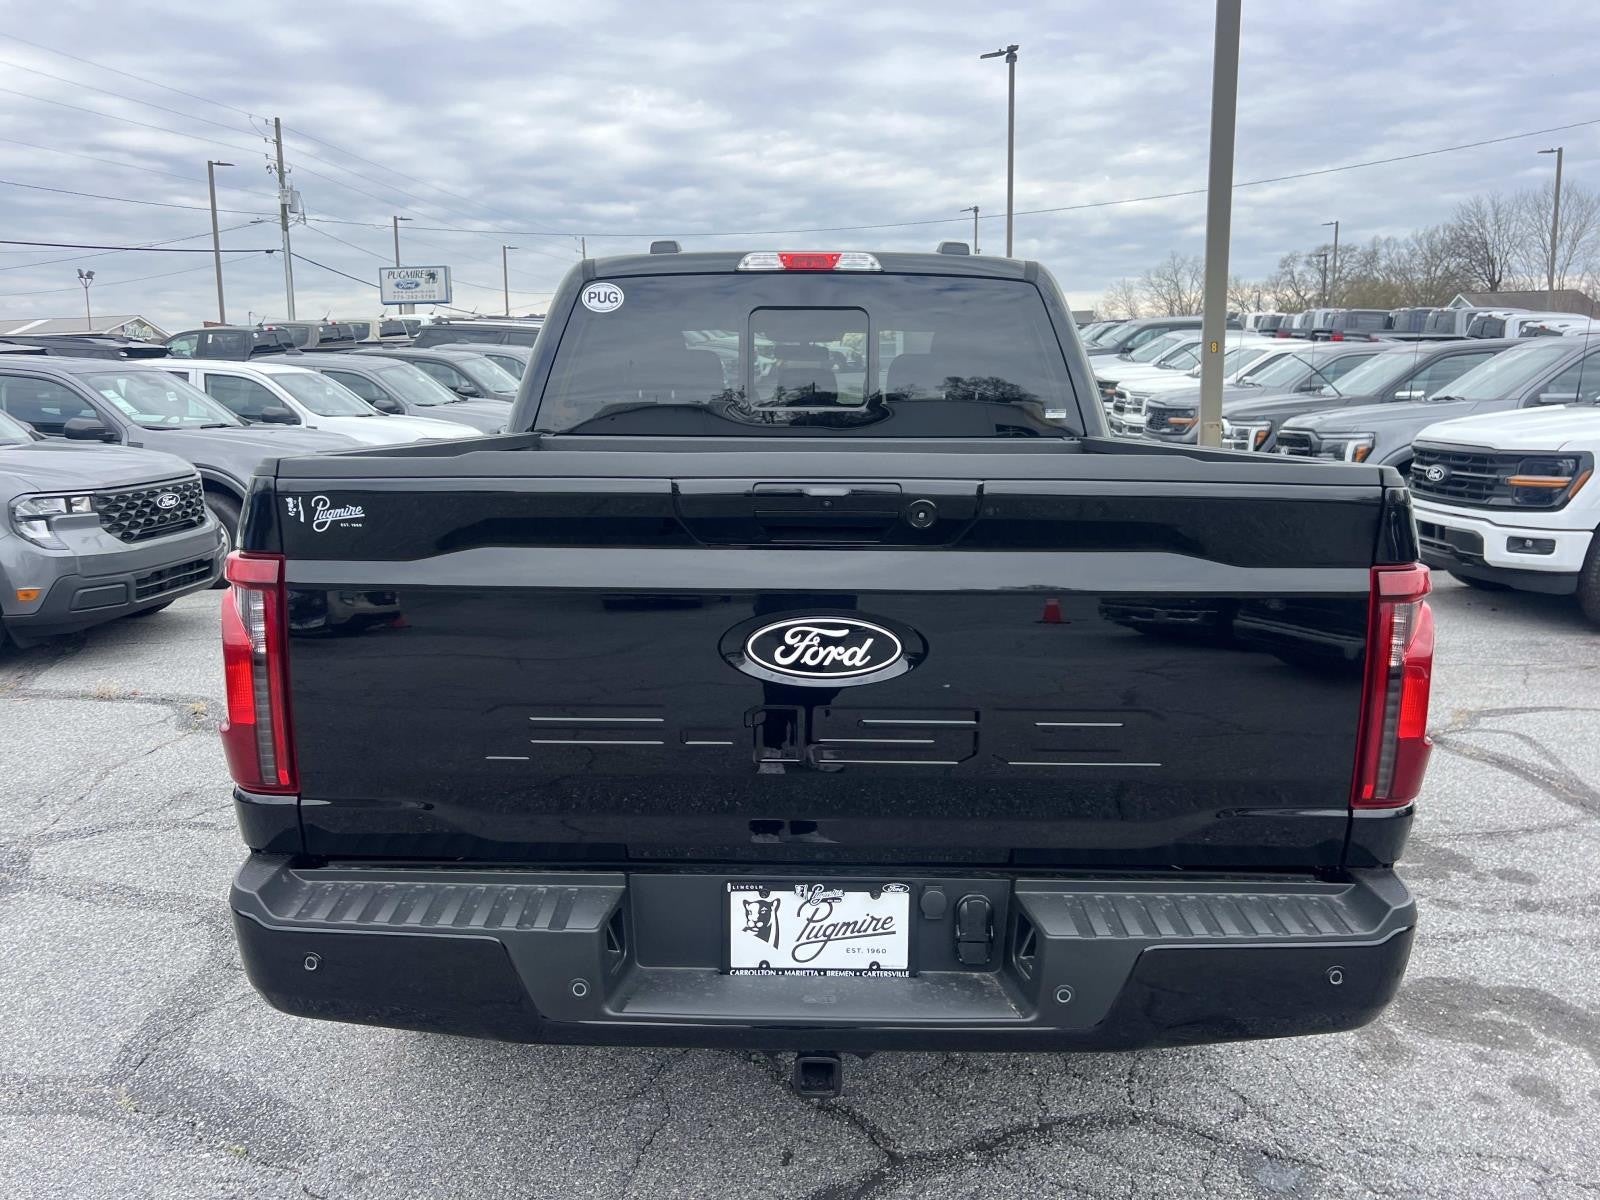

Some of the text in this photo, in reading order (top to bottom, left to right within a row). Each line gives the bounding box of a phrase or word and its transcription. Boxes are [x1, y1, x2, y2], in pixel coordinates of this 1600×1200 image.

[387, 269, 425, 279] PUGMIRE
[588, 291, 619, 304] PUG
[311, 495, 365, 532] Pugmire
[773, 626, 874, 667] Ford
[791, 900, 897, 964] Pugmire
[861, 970, 911, 979] CARTERSVILLE
